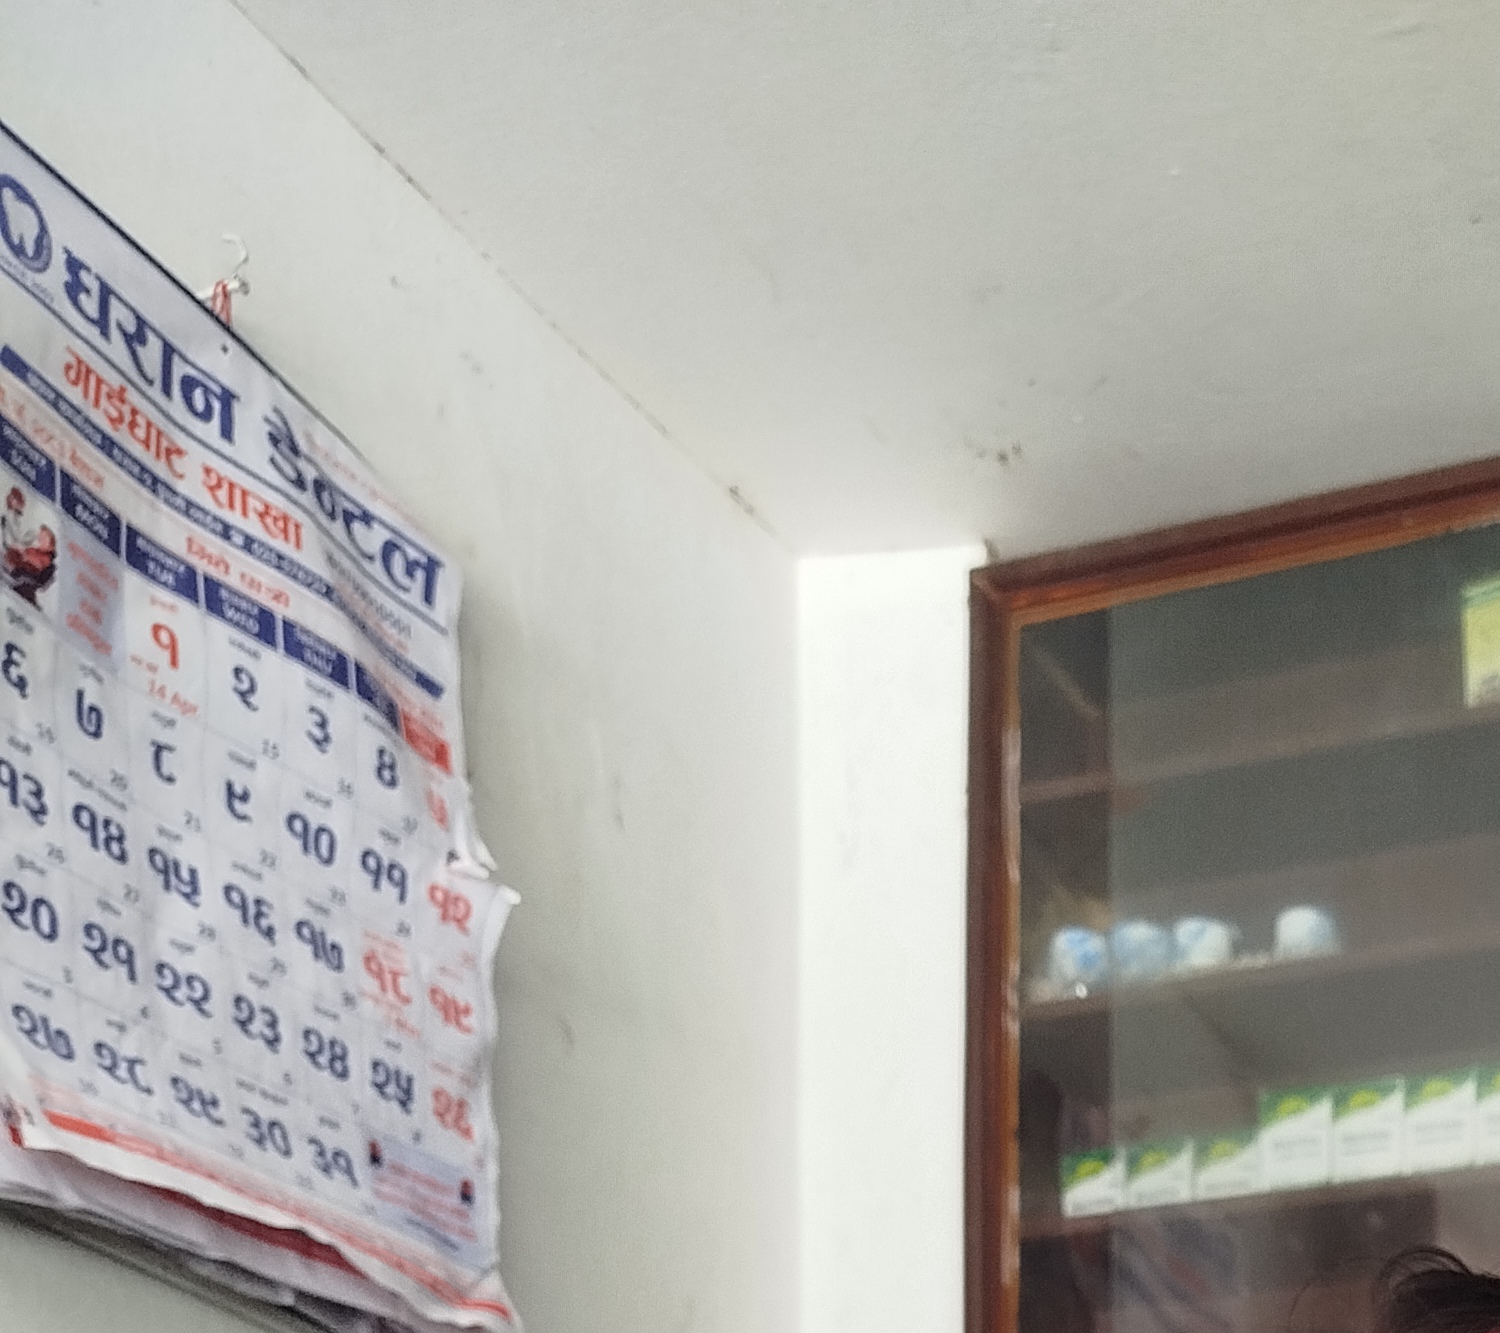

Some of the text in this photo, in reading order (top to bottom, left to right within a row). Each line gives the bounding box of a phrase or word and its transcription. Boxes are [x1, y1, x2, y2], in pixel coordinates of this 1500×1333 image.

[64, 346, 187, 480] गाईघाट
[202, 463, 303, 551] शाखा
[1, 640, 29, 700] ६
[151, 622, 180, 670] १
[75, 688, 105, 740] ७
[231, 664, 260, 712] २
[305, 704, 333, 754] ३
[149, 738, 177, 785] ८
[375, 745, 400, 790] ४
[72, 801, 129, 866] १४
[285, 811, 338, 867] १०
[148, 846, 202, 908] १५
[360, 847, 409, 906] ११
[1, 879, 60, 944] २०
[222, 882, 277, 948] १६
[82, 920, 139, 985] २१
[294, 917, 346, 974] १७
[154, 960, 215, 1019] २२
[11, 1002, 76, 1062] २७
[232, 992, 282, 1055] २३
[93, 1039, 155, 1097] २८
[302, 1026, 351, 1083] २४
[370, 1055, 415, 1116] २५
[241, 1106, 293, 1159] ३०
[307, 1135, 359, 1189] ३१
